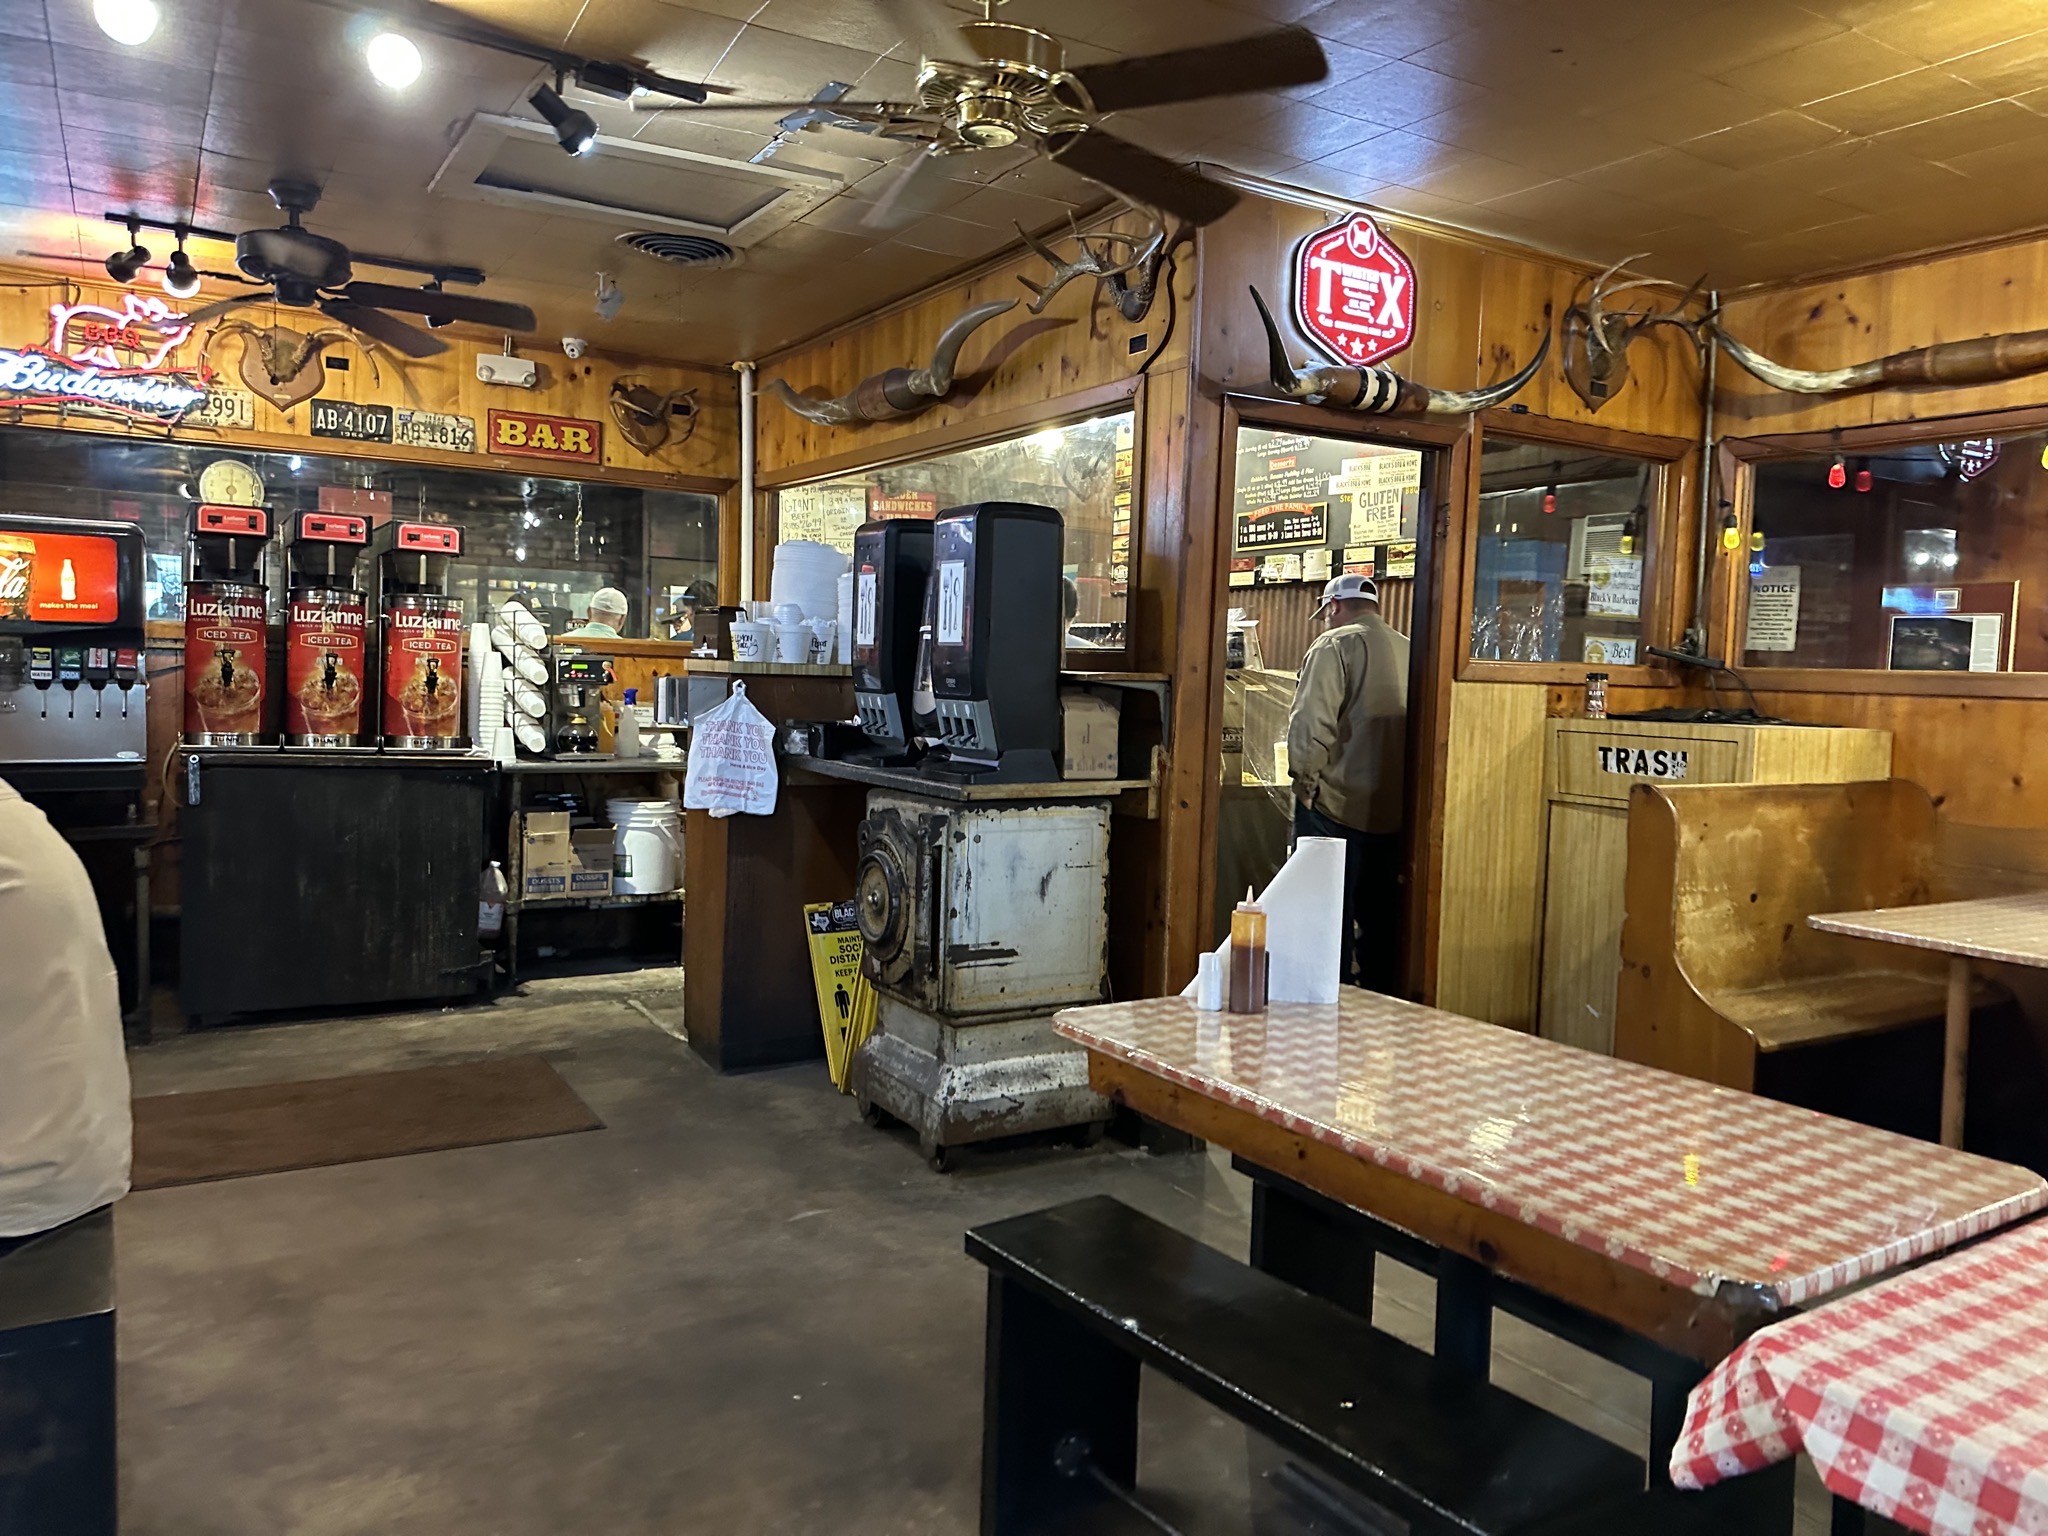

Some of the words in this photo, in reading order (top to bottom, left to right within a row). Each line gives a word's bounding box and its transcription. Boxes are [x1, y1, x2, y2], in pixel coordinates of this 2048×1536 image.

[84, 320, 139, 348] BBQ
[0, 352, 206, 410] Budweiser
[497, 419, 592, 453] BAR
[1269, 459, 1296, 469] Desserts
[1379, 461, 1394, 469] BLACK'S
[1378, 475, 1393, 484] BLACK'S
[872, 500, 933, 511] SANDWICHES
[1359, 488, 1399, 508] GLUTEN
[791, 512, 811, 520] BEEF
[1254, 506, 1270, 517] FEED
[1271, 503, 1284, 511] THE
[1285, 502, 1309, 511] FAMILY
[1366, 505, 1395, 522] FREE
[1754, 584, 1796, 592] NOTICE
[1612, 594, 1638, 605] Barbecue
[190, 598, 263, 619] Luzianne
[294, 605, 363, 626] Luzianne
[395, 611, 461, 631] Luzianne
[203, 630, 228, 639] ICED
[232, 631, 251, 640] TEA
[307, 635, 331, 644] ICED
[334, 637, 352, 645] TEA
[409, 641, 432, 649] ICED
[436, 642, 451, 650] TEA
[1612, 643, 1631, 658] Best
[61, 671, 79, 680] SODA
[706, 721, 743, 734] THANK
[746, 723, 766, 737] YOU
[702, 733, 742, 747] THANK
[744, 736, 766, 751] YOU
[700, 747, 742, 762] THANK
[743, 750, 767, 764] YOU
[835, 968, 852, 977] KEEP
